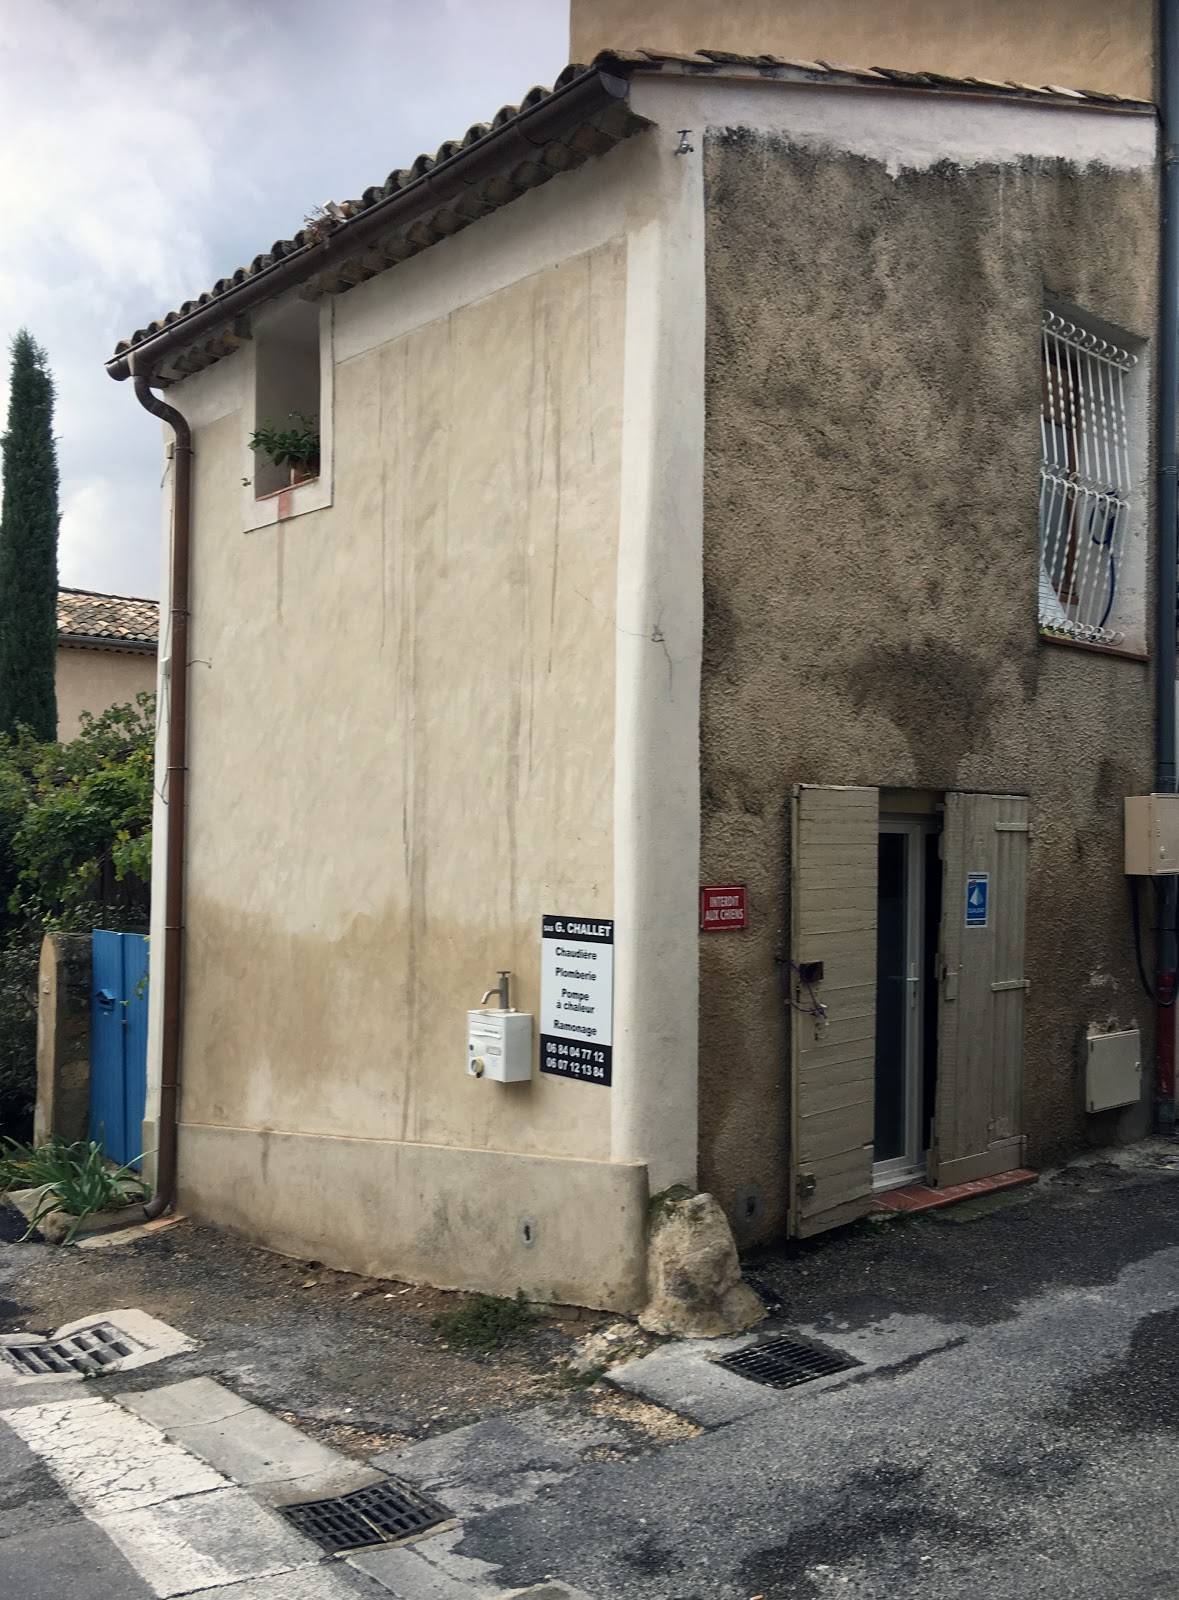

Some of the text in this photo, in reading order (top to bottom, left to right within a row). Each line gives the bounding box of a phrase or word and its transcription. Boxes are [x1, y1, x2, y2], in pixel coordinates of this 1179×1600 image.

[710, 896, 739, 907] INTERDIT
[705, 909, 744, 920] AUX CHIENS
[555, 922, 565, 932] G.
[567, 923, 611, 936] CHALLET
[556, 947, 597, 960] Chaudière
[556, 967, 597, 981] Plomberie
[562, 988, 589, 1002] Pompe
[556, 1000, 595, 1013] à chaleur
[554, 1020, 597, 1036] Ramonage
[546, 1042, 604, 1062] 06 84 04 77 12
[546, 1057, 604, 1078] 06 07 12 13 84
